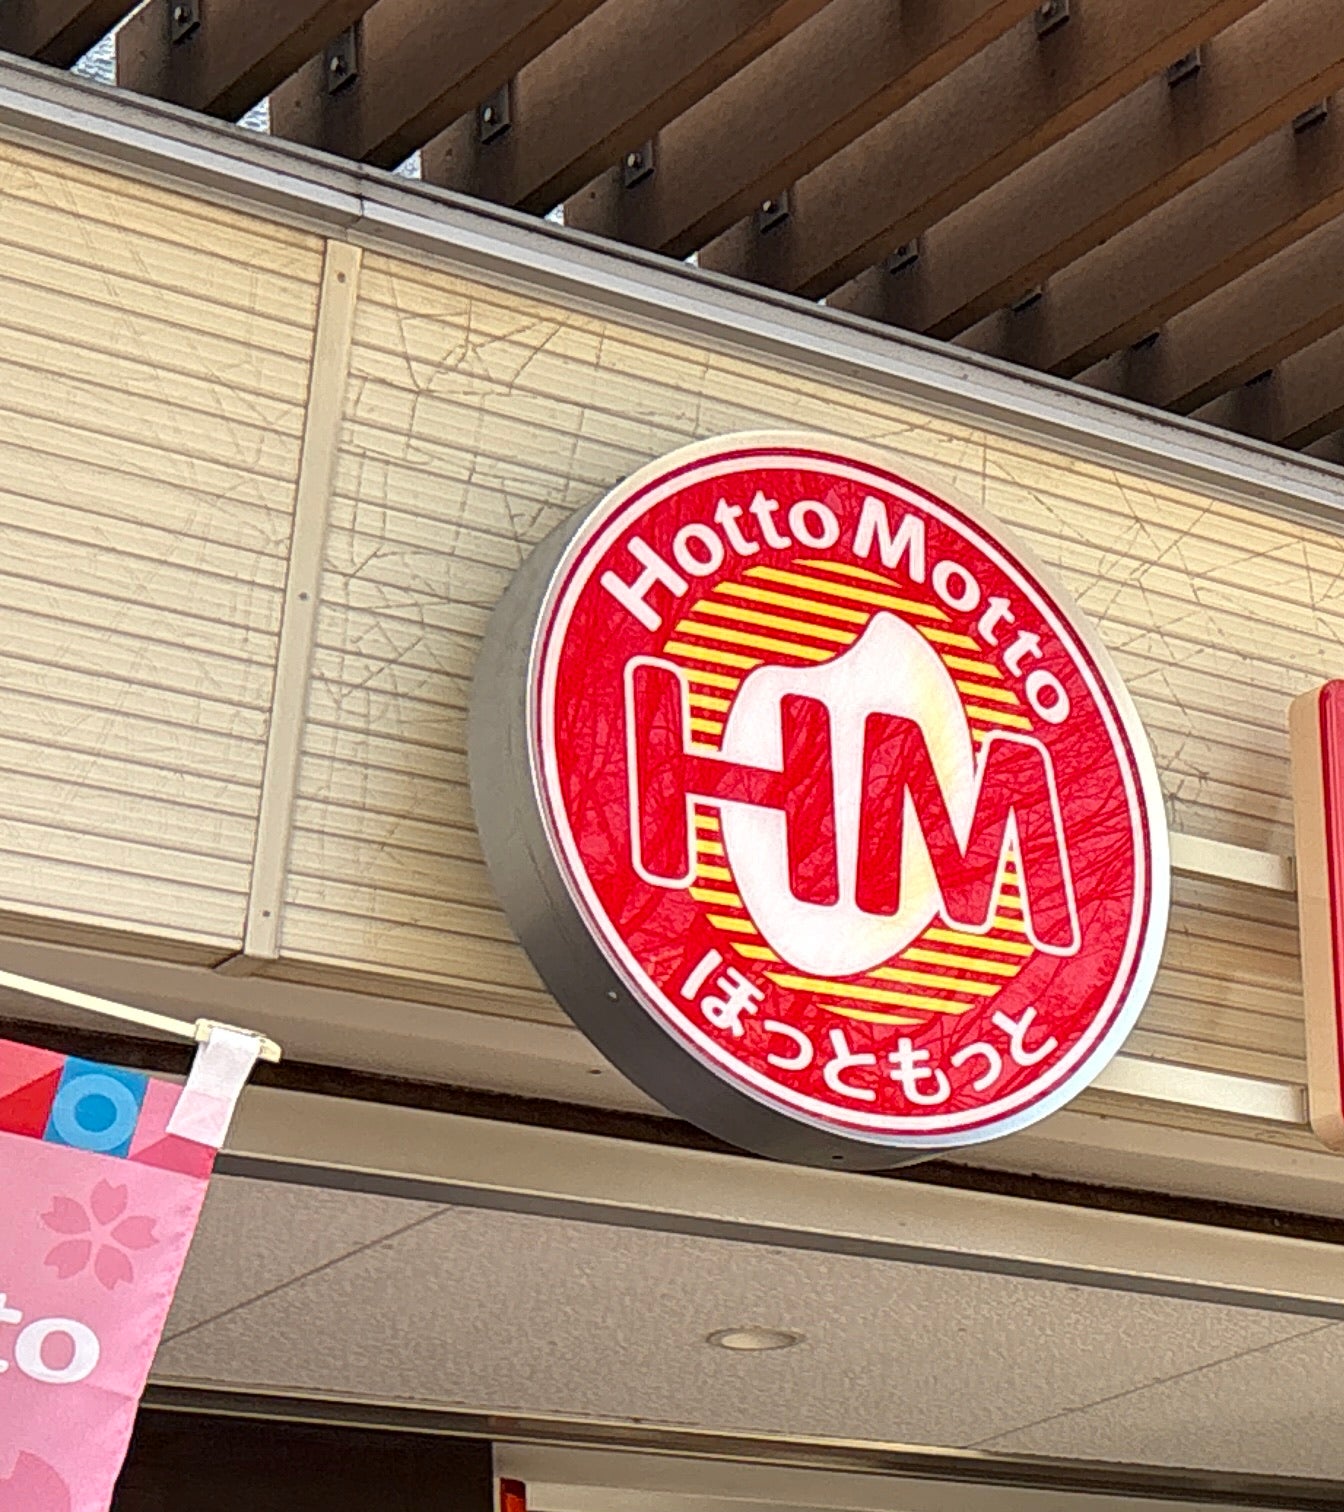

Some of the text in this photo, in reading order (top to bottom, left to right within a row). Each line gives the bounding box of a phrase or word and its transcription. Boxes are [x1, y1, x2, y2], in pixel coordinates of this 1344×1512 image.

[679, 948, 1058, 1106] ほっともっと
